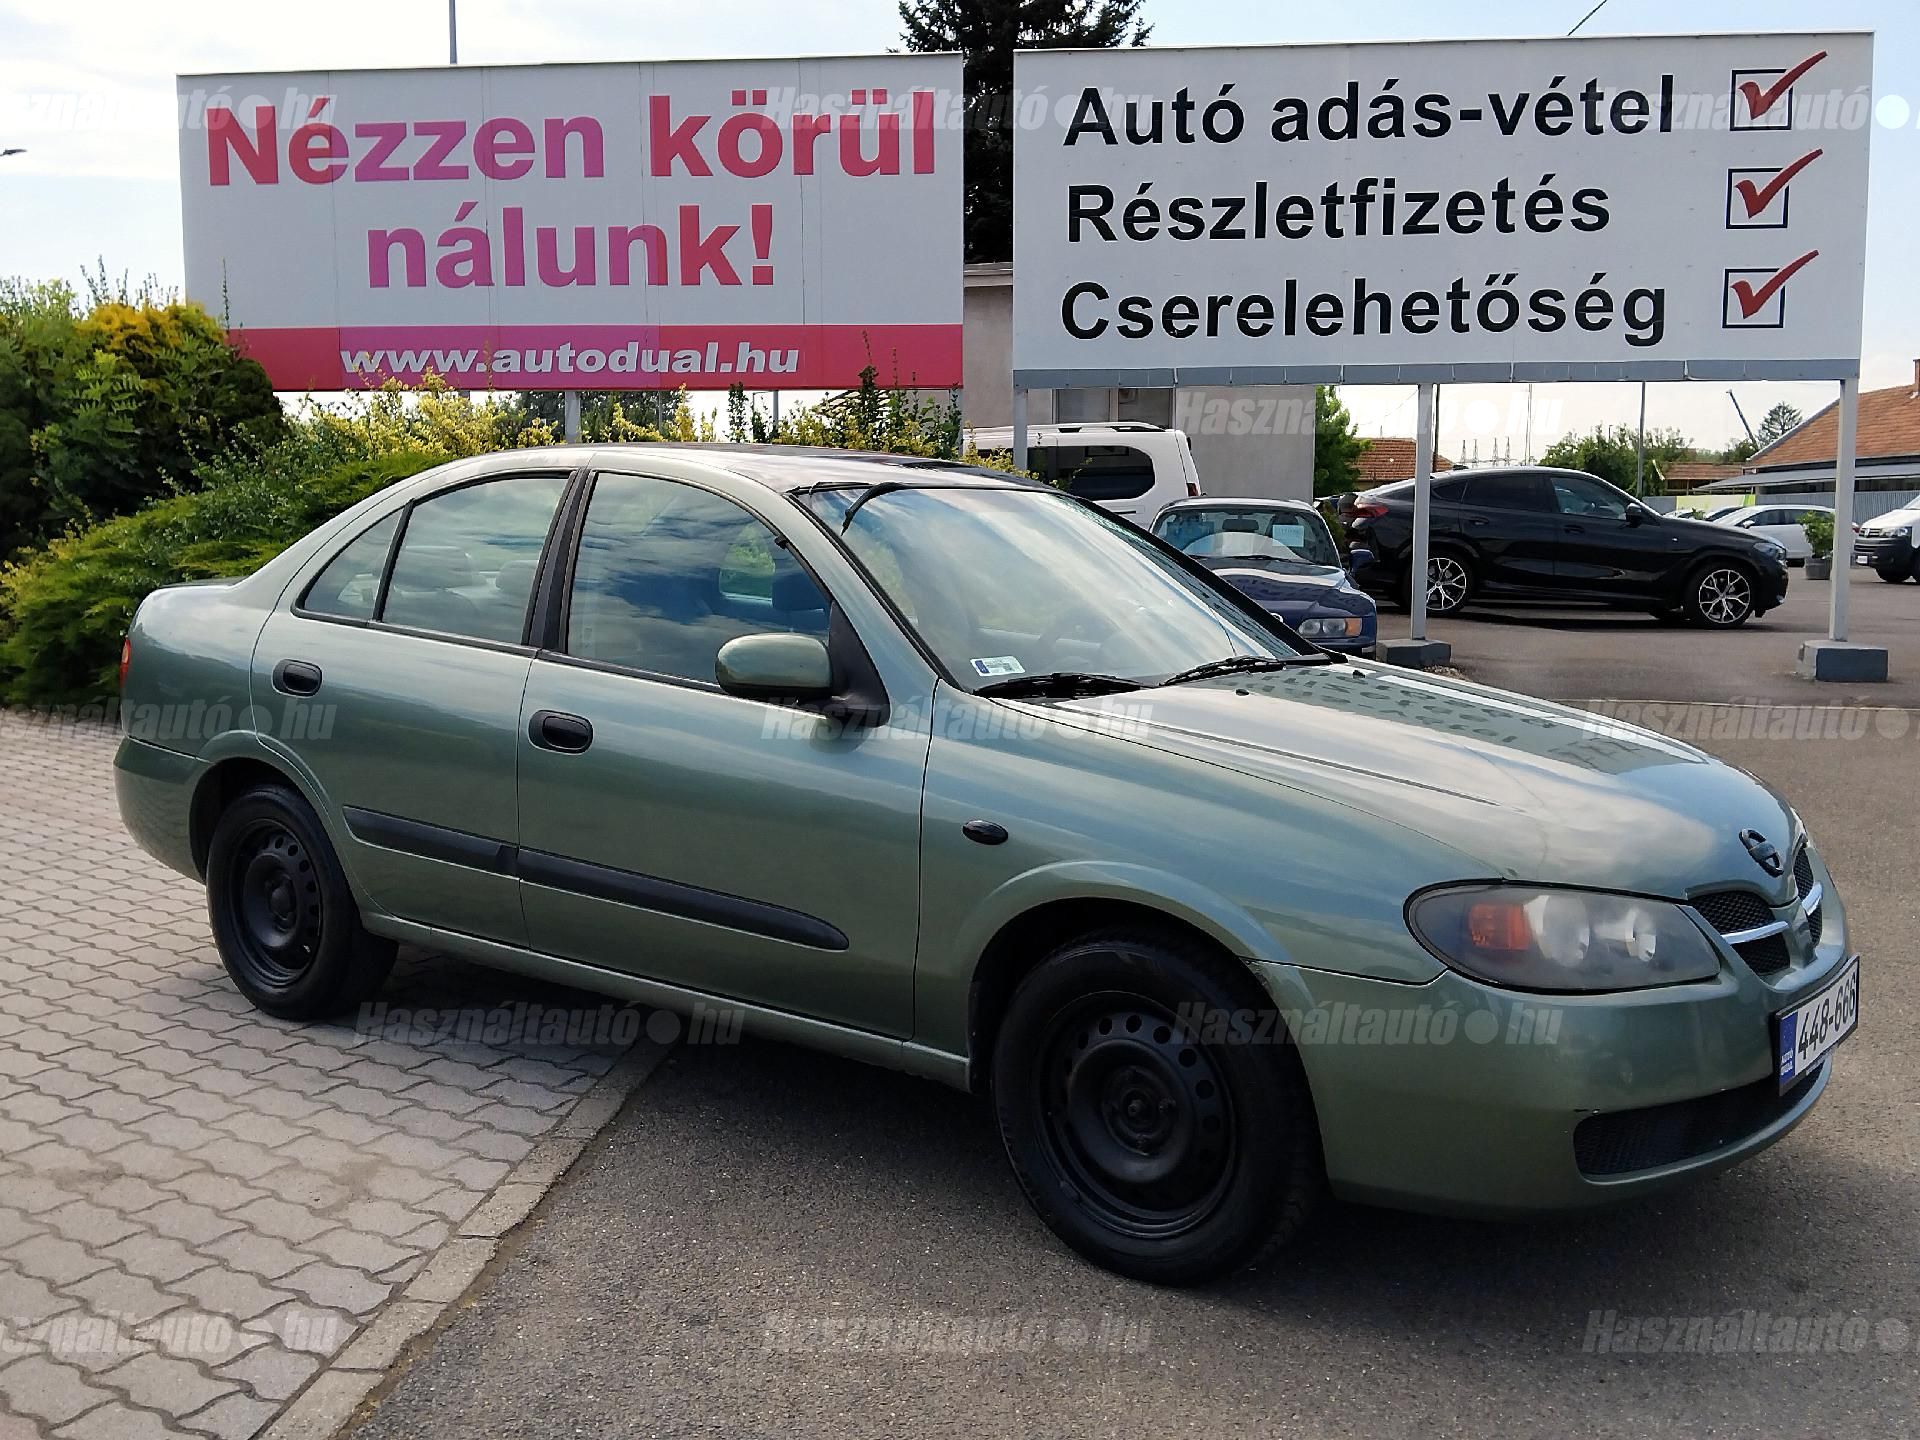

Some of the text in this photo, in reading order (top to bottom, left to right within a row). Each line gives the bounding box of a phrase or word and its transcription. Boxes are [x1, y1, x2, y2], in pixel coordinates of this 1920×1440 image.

[207, 88, 935, 186] Nézzen körül
[1062, 74, 1674, 147] Autó adás-vétel
[367, 202, 775, 289] nálunk!
[1068, 173, 1611, 243] Részletfizetés
[1061, 272, 1666, 347] Cserelehetőség
[340, 341, 799, 376] www.autodual.hu
[1797, 971, 1856, 1060] 448-666
